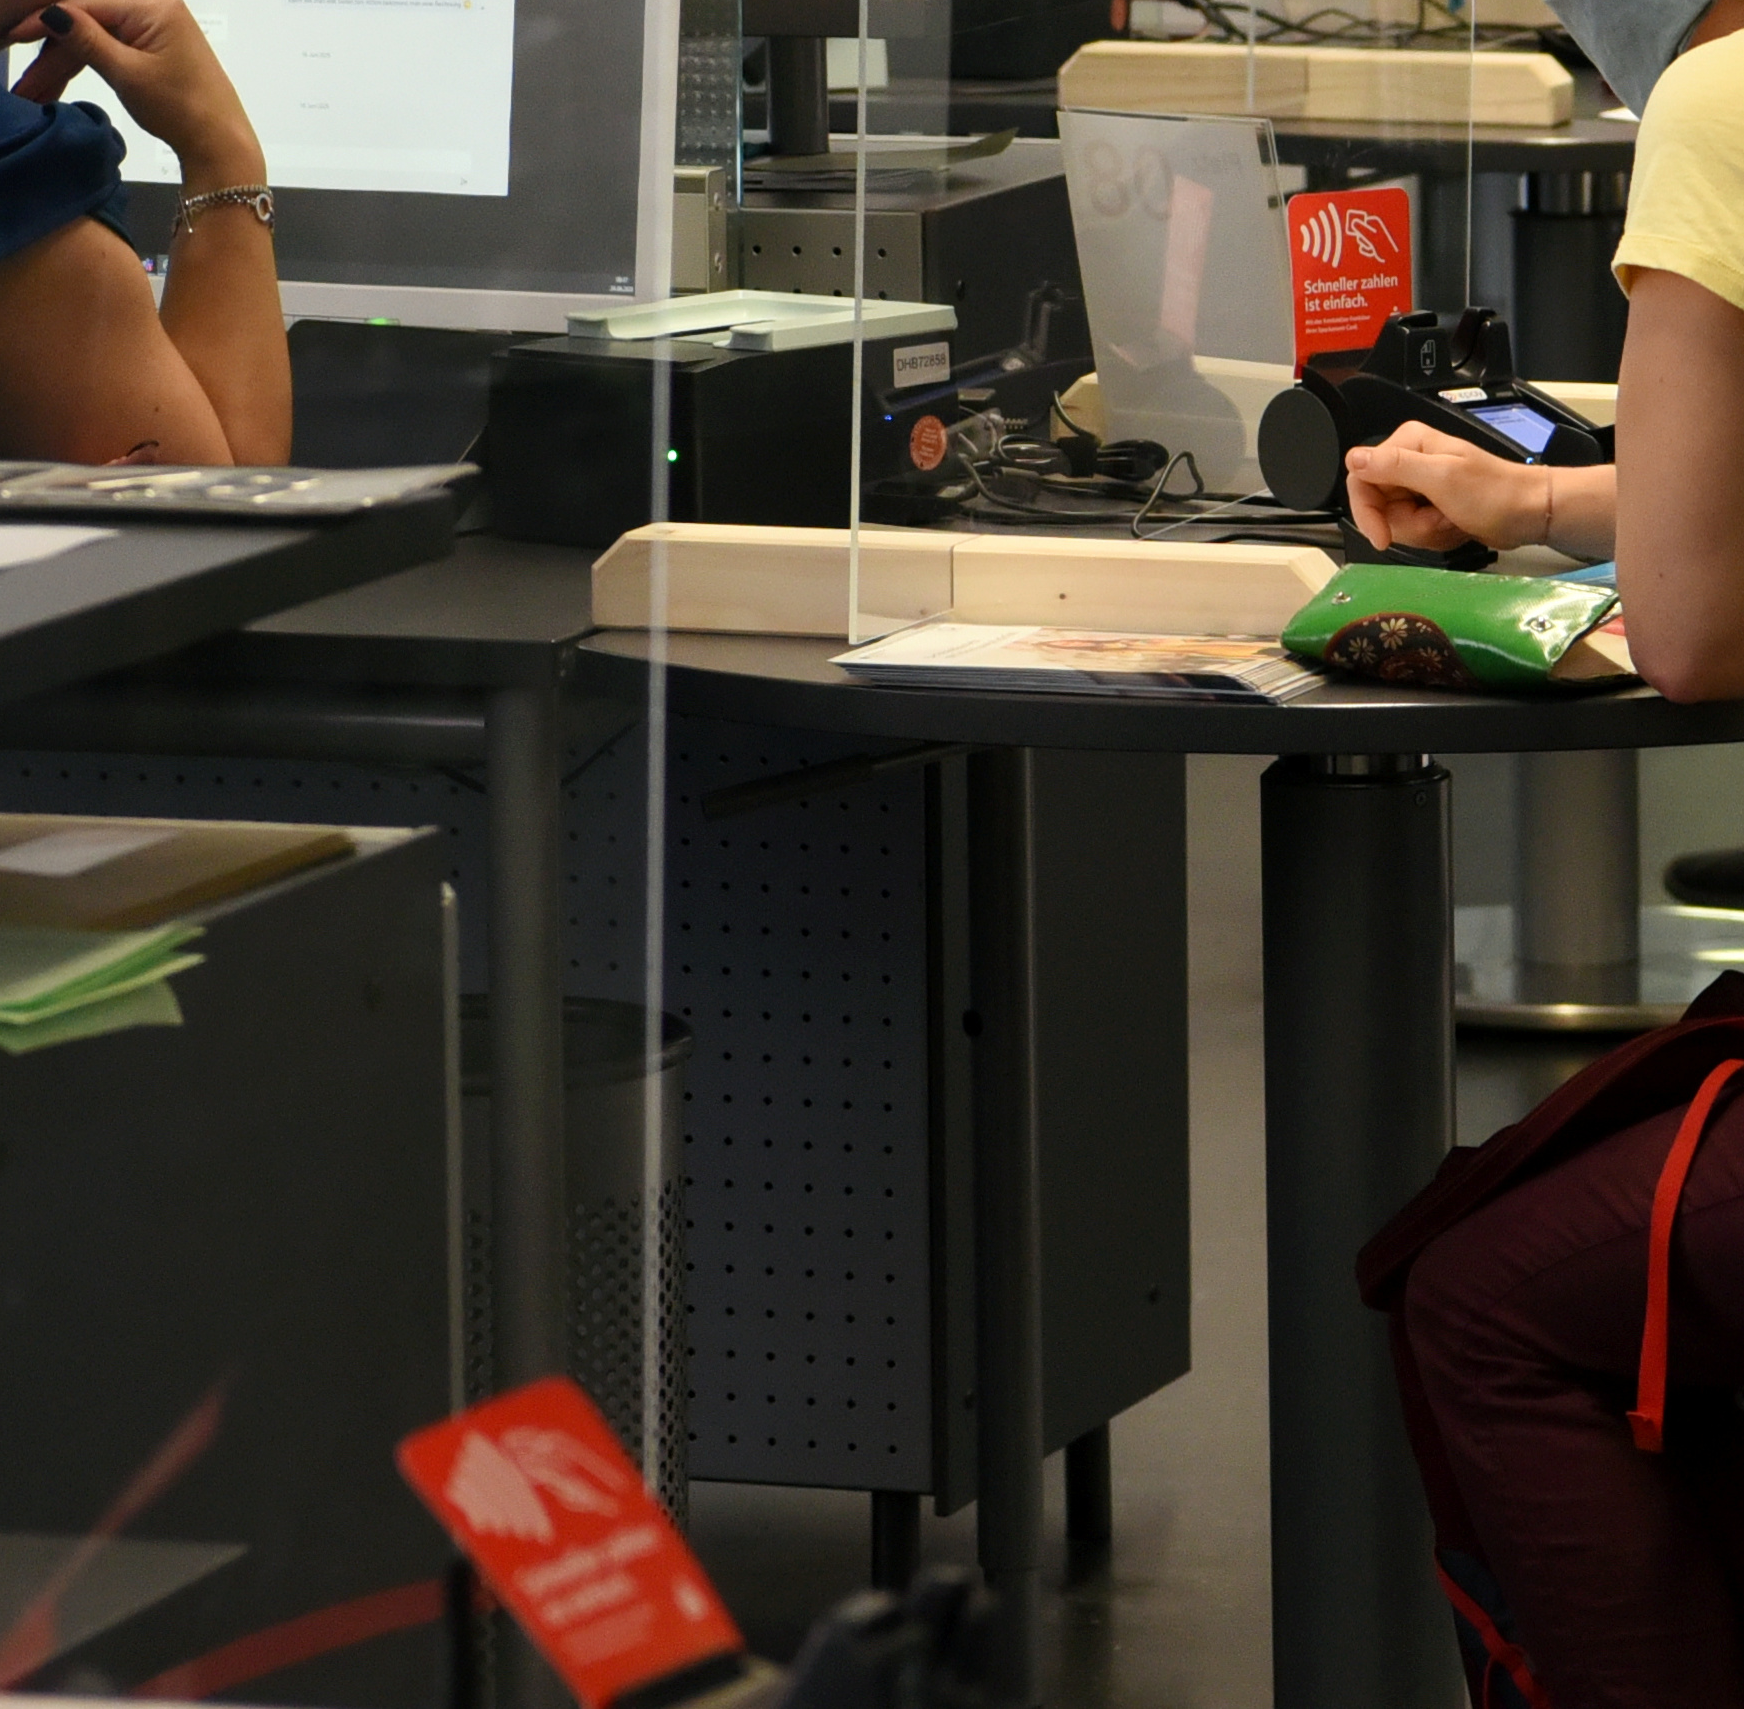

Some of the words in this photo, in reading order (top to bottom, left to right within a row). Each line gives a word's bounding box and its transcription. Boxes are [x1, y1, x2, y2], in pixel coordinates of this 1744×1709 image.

[1304, 276, 1358, 295] Schneller
[1360, 273, 1398, 290] zahlen
[1305, 297, 1321, 312] ist
[1323, 293, 1368, 311] einfach.
[896, 352, 946, 372] DHB72858
